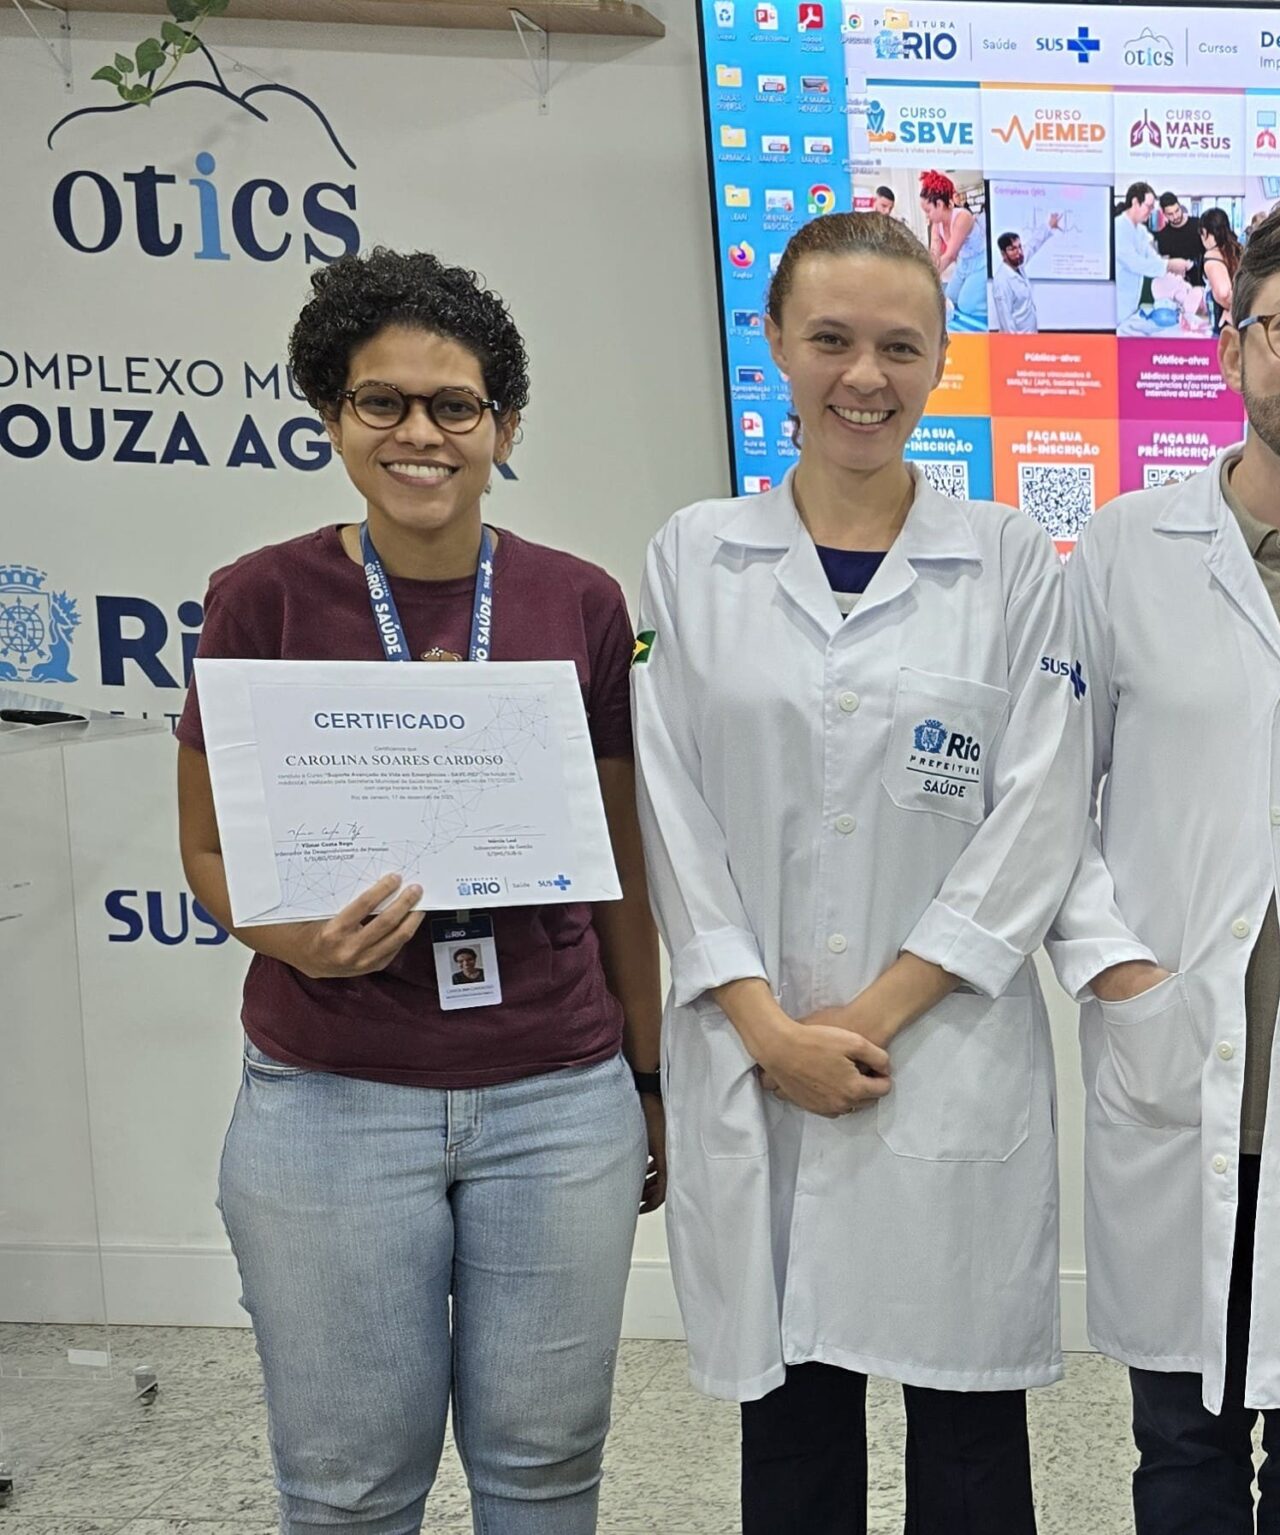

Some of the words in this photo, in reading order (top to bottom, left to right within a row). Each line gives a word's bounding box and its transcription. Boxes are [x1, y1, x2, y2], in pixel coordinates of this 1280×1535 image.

[902, 32, 957, 60] RIO
[983, 38, 1017, 50] Saúde
[1036, 37, 1064, 51] SUS
[1124, 47, 1174, 66] otics
[1199, 42, 1238, 54] Cursos
[900, 107, 947, 119] CURSO
[1035, 108, 1081, 120] CURSO
[1166, 109, 1211, 121] CURSO
[900, 121, 973, 145] SBVE
[1035, 123, 1106, 142] IEMED
[1166, 122, 1214, 136] MANE
[1167, 136, 1231, 150] VA-SUS
[52, 151, 361, 264] otics
[931, 428, 955, 439] SUA
[1027, 430, 1057, 442] FAÇA
[1059, 431, 1082, 441] SUA
[1153, 432, 1184, 446] FAÇA
[1185, 433, 1209, 445] SUA
[1012, 443, 1100, 456] PRÉ-INSCRIÇÃO
[367, 573, 385, 600] RIO
[475, 593, 492, 645] SAÚDE
[374, 602, 402, 656] SAÚDE
[1040, 656, 1070, 677] SUS
[314, 712, 465, 730] CERTIFICADO
[946, 732, 981, 762] Rio
[285, 755, 368, 767] CAROLINA
[372, 755, 430, 766] SOARES
[433, 755, 504, 766] CARDOSO
[923, 779, 966, 798] SAÚDE
[472, 881, 500, 895] RIO
[538, 880, 553, 888] SUS
[105, 889, 231, 946] SUS
